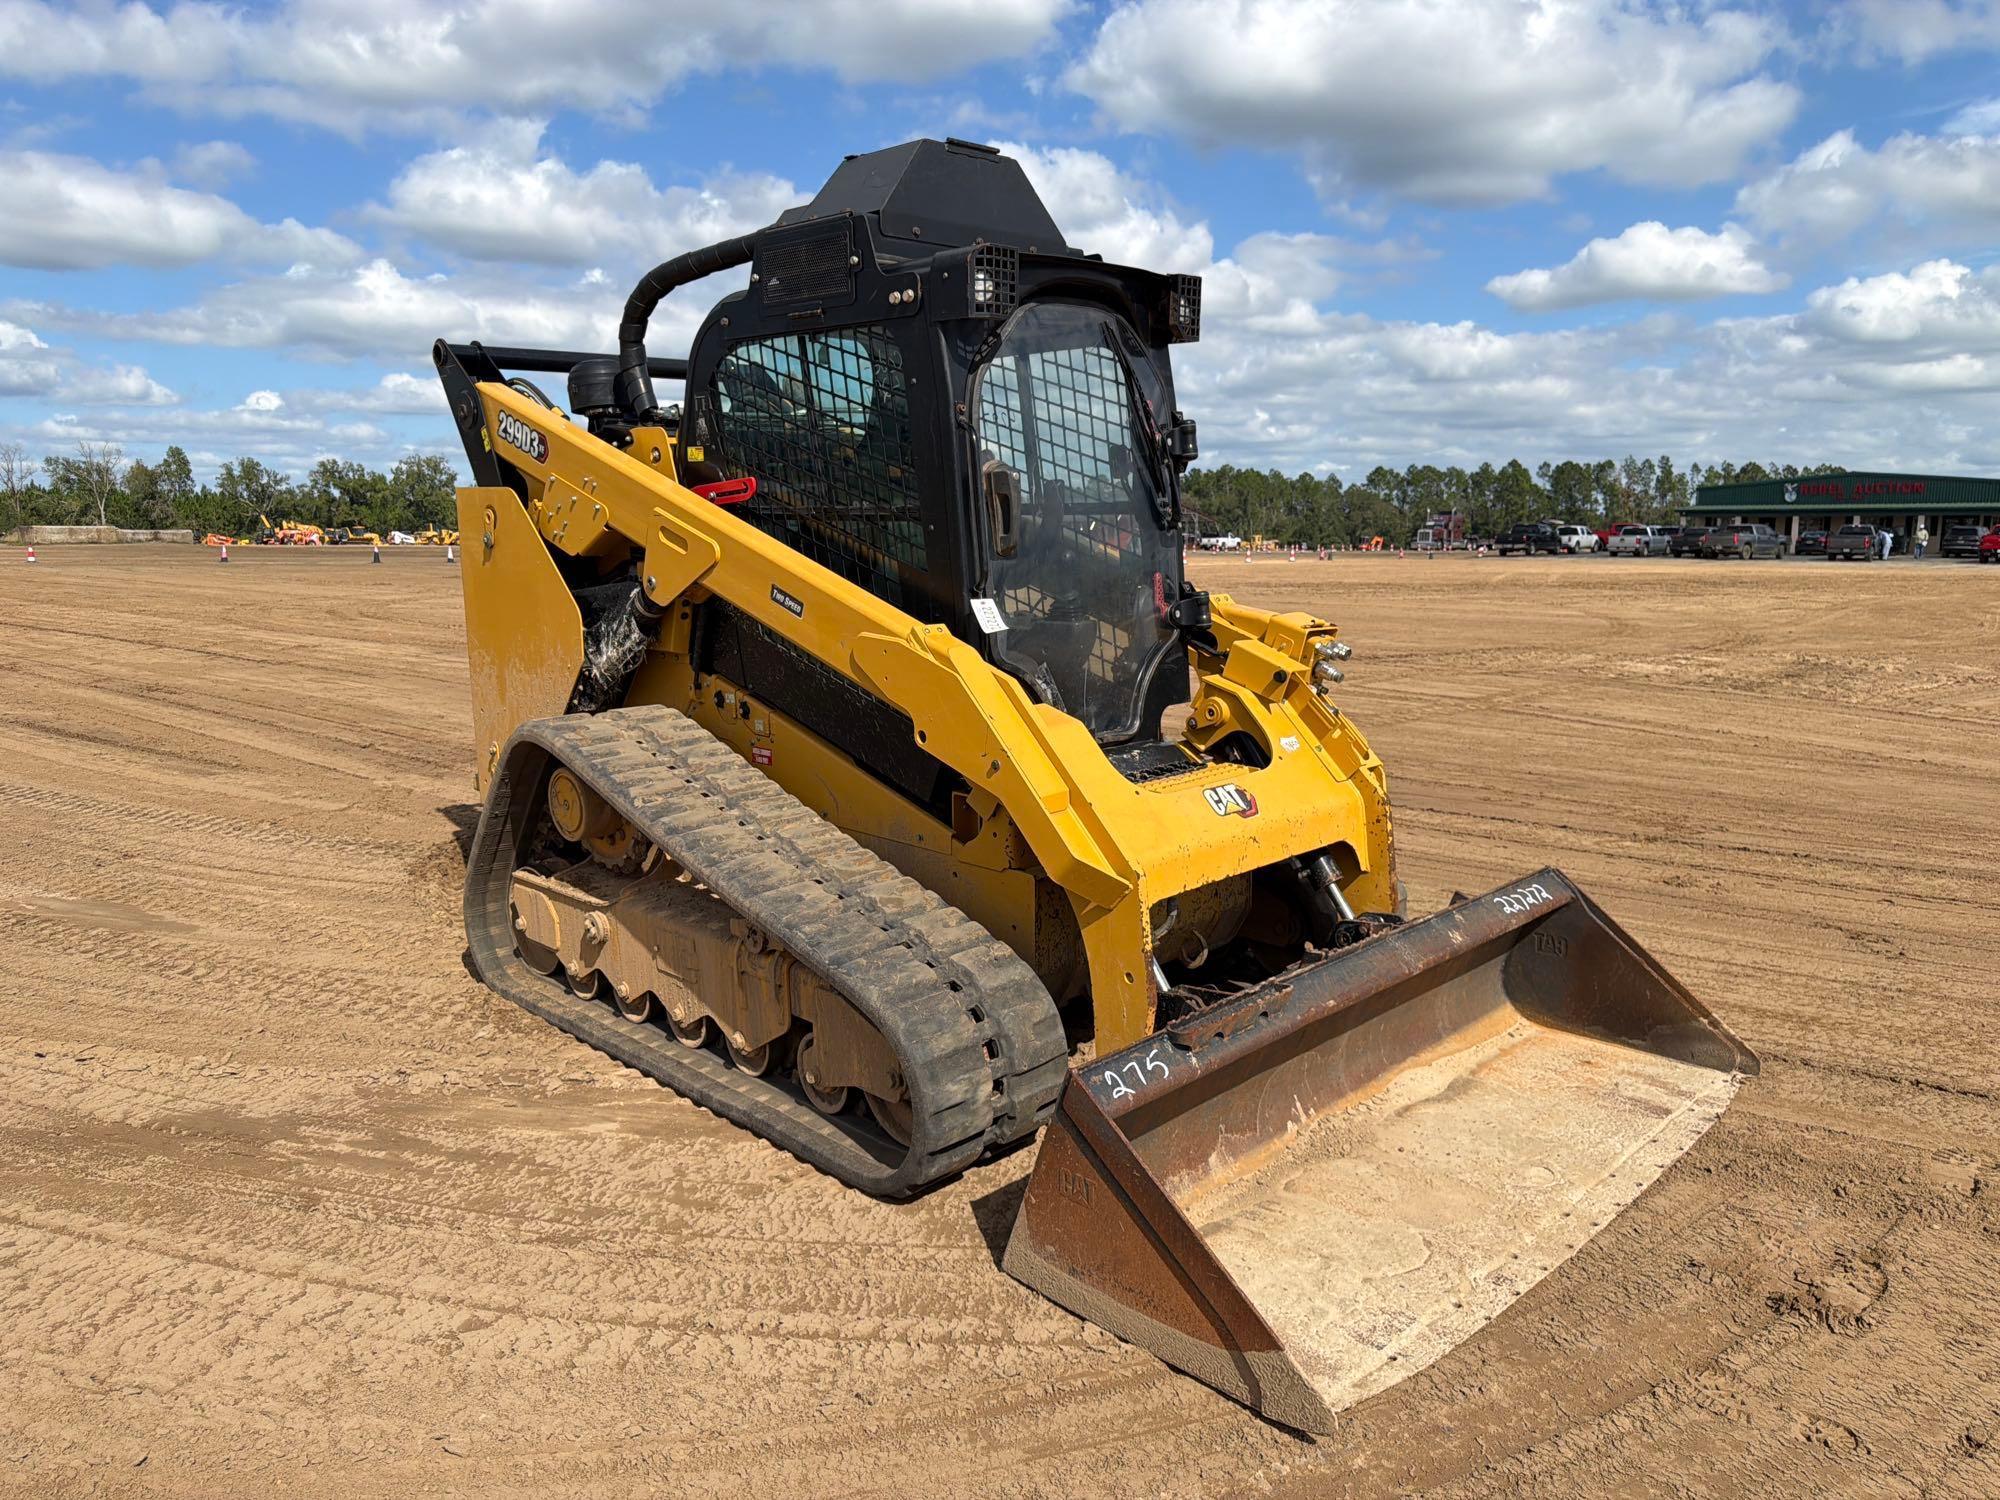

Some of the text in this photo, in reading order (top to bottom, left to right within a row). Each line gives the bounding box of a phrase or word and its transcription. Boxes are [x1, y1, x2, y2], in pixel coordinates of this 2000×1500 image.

[497, 410, 539, 458] 299D3
[1203, 783, 1249, 816] CAT
[1493, 883, 1553, 914] 227272
[1104, 1049, 1169, 1099] 275
